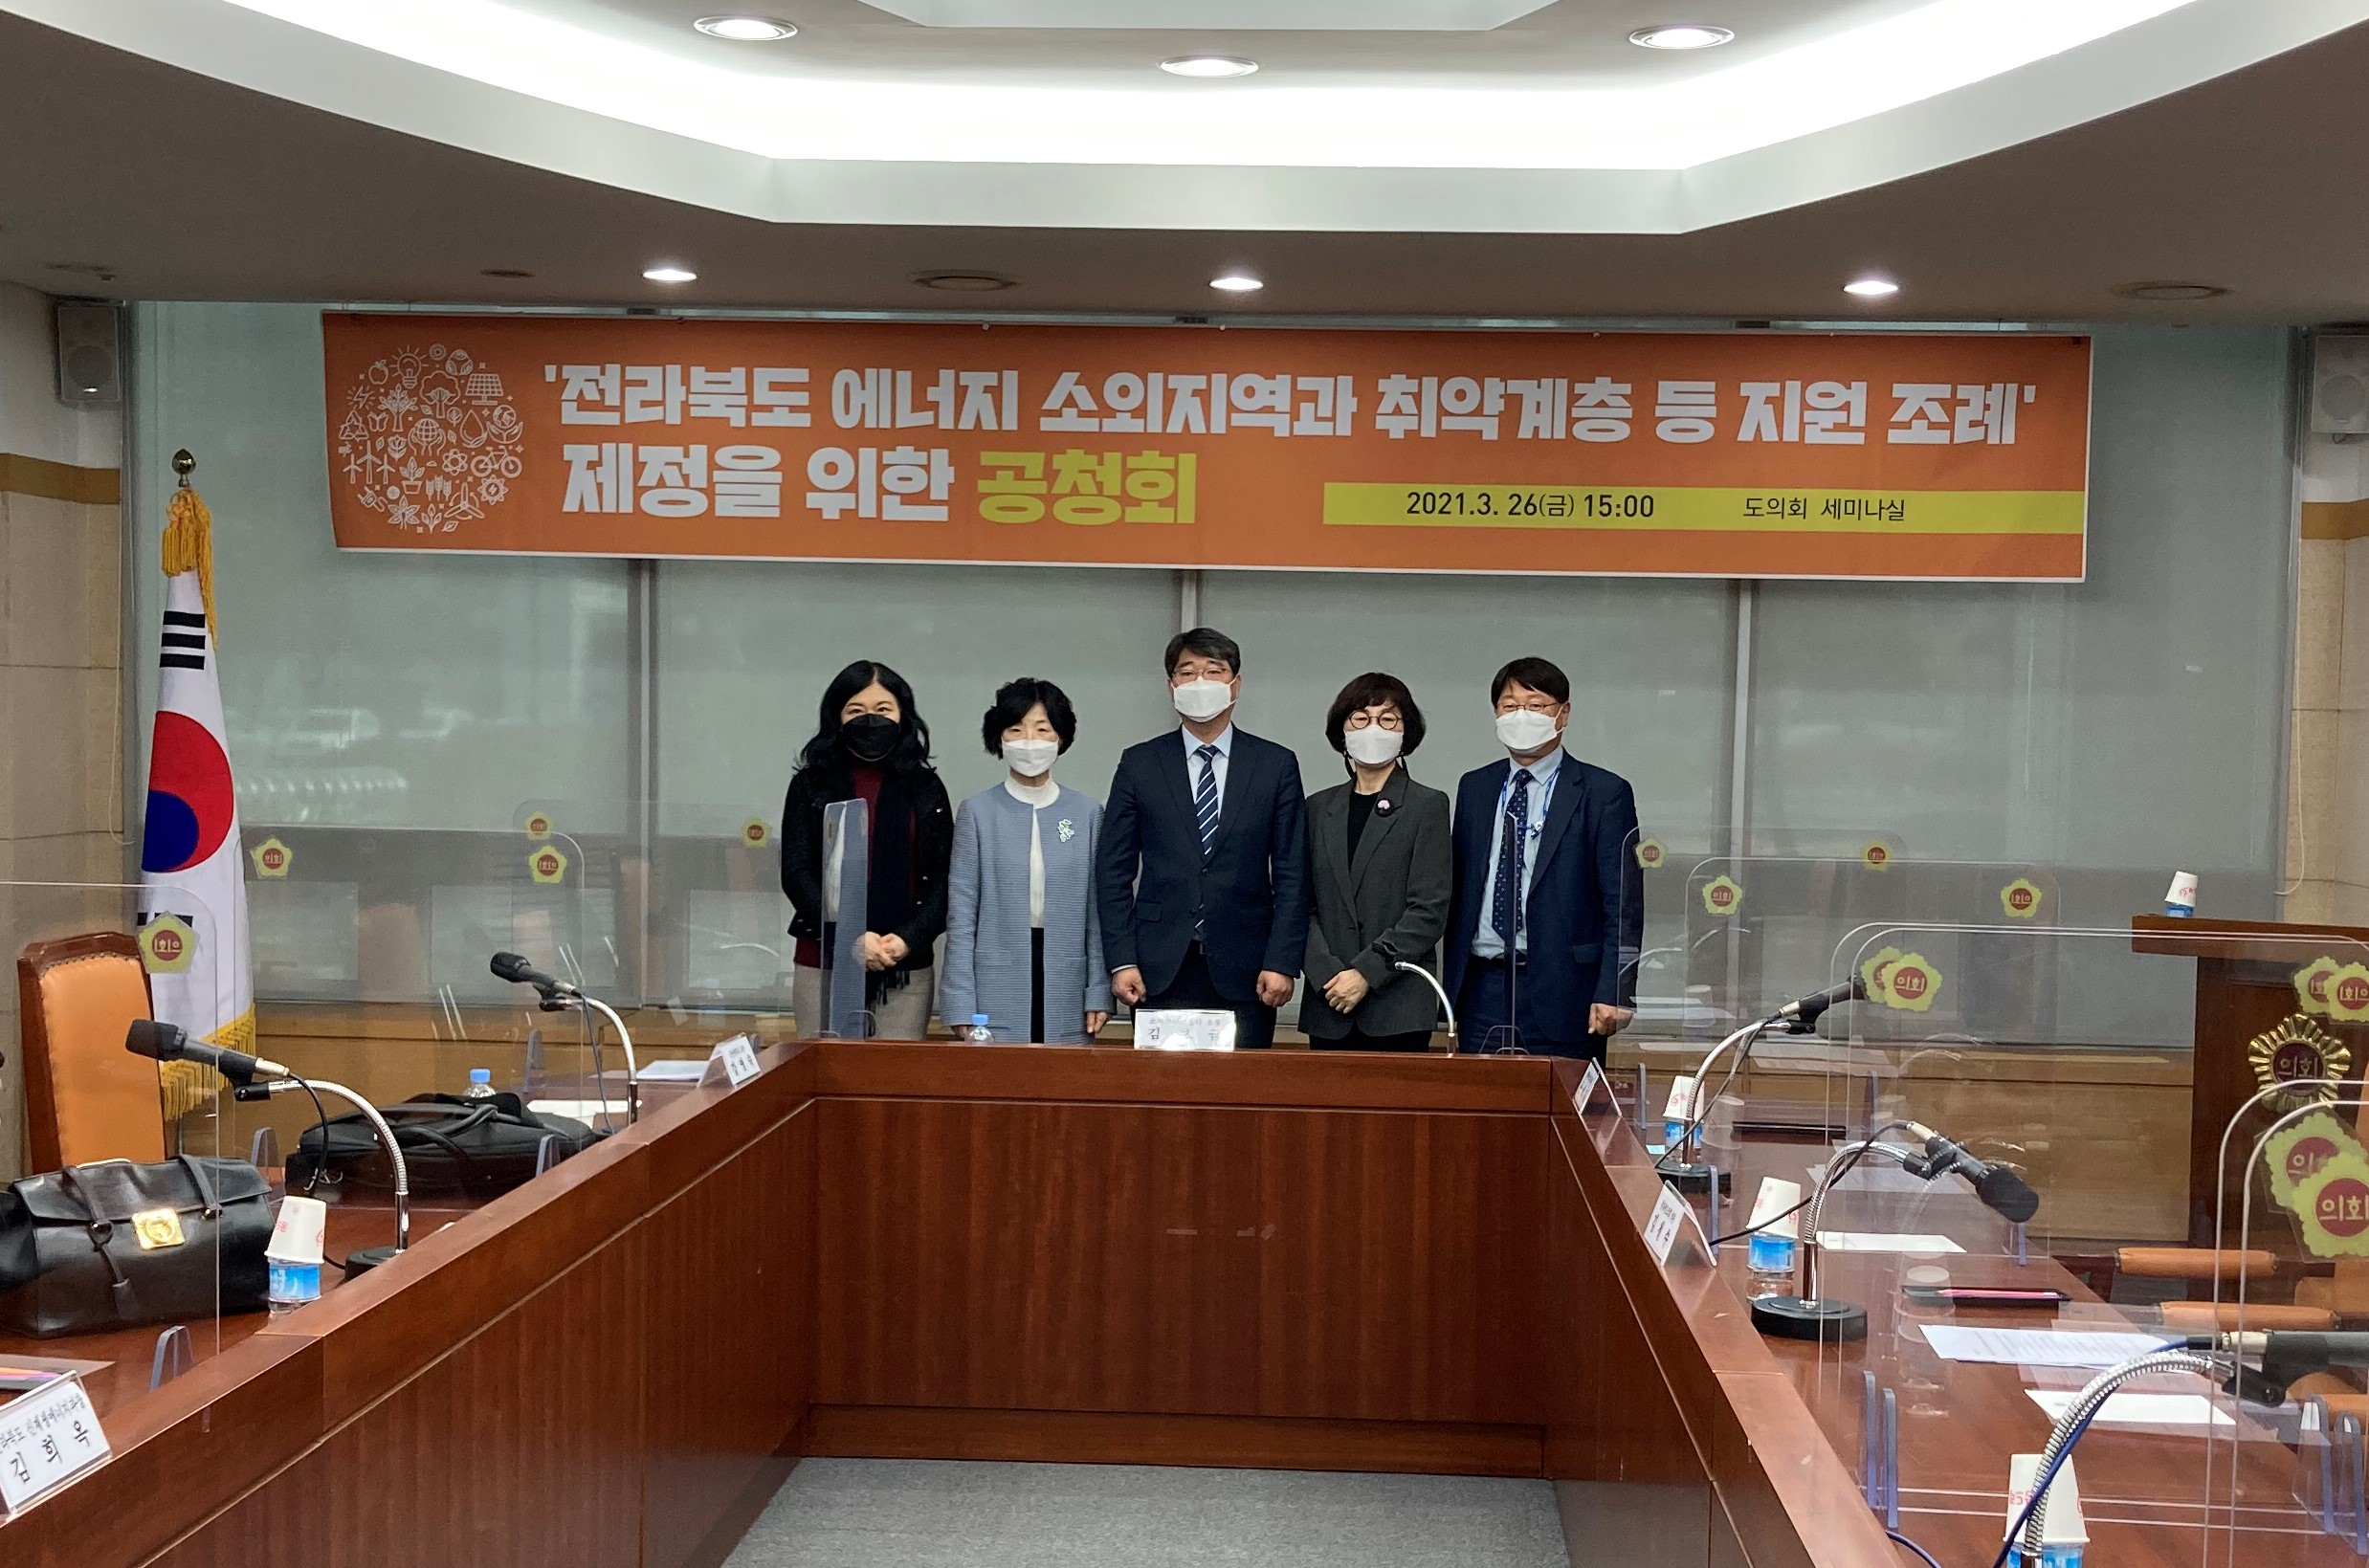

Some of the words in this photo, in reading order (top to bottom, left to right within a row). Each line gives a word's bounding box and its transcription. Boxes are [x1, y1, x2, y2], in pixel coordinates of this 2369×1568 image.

[544, 364, 812, 428] '전라북도
[831, 368, 1019, 431] 에너지
[1039, 371, 1358, 438] 소외지역과
[1375, 373, 1632, 443] 취약계층
[1654, 380, 1717, 444] 등
[1737, 380, 1868, 445] 지원
[1887, 383, 2037, 445] 조례'
[562, 443, 783, 519] 제정을
[806, 446, 955, 522] 위한
[977, 449, 1198, 525] 공청회
[1406, 492, 1499, 517] 2021.3.
[1507, 493, 1575, 519] 26(금)
[1584, 495, 1654, 519] 15:00
[1743, 497, 1807, 520] 도의회
[1820, 497, 1906, 522] 세미나실
[264, 854, 283, 865] 의회
[1713, 892, 1731, 902] 의회
[1894, 976, 1924, 992] 의회
[2276, 1056, 2317, 1079] 의회
[2319, 1195, 2369, 1222] 의회
